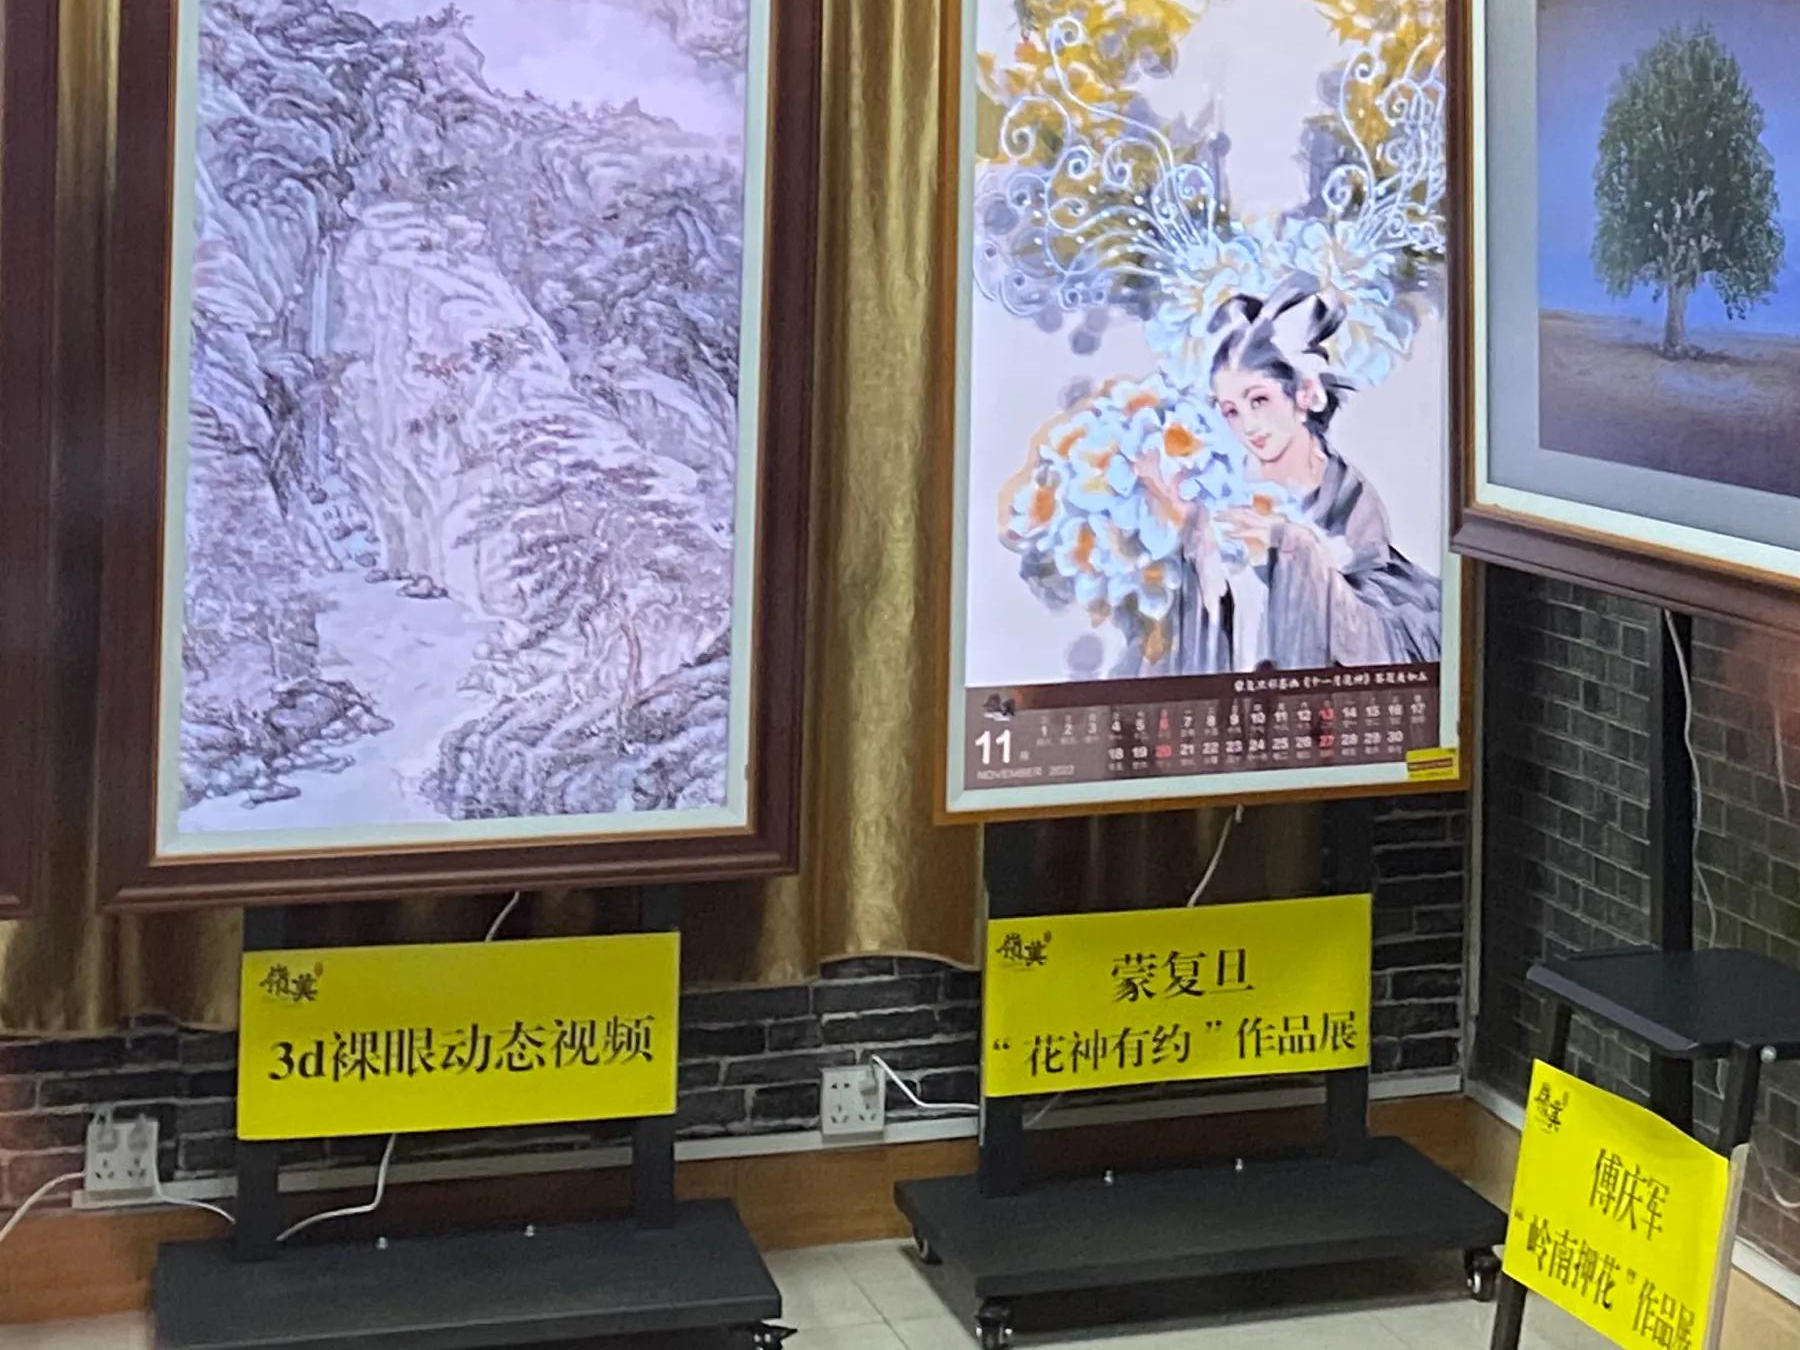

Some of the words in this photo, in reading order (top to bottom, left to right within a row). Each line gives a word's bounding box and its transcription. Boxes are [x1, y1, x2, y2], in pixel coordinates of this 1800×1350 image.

[1041, 725, 1048, 737] 1
[1064, 723, 1073, 735] 2
[1088, 722, 1097, 734] 3
[1111, 720, 1121, 732] 4
[1135, 718, 1145, 731] 5
[1184, 716, 1193, 727] 7
[1206, 715, 1216, 727] 8
[1230, 714, 1239, 726] 9
[1251, 712, 1266, 724] 10
[1274, 710, 1288, 722] 11
[1297, 709, 1312, 721] 12
[1342, 706, 1358, 718] 14
[1365, 705, 1380, 717] 15
[1388, 704, 1403, 716] 16
[1410, 702, 1426, 715] 17
[974, 728, 1011, 765] 11
[1108, 747, 1124, 760] 18
[1132, 746, 1148, 758] 19
[1180, 743, 1195, 756] 21
[1202, 741, 1219, 755] 22
[1249, 738, 1265, 752] 24
[1272, 737, 1289, 749] 25
[1319, 734, 1335, 747] 27
[1341, 733, 1358, 746] 28
[1364, 732, 1381, 745] 29
[1387, 730, 1404, 743] 30
[1111, 947, 1255, 1003] 蒙复旦
[268, 1014, 656, 1083] 3d裸眼动态视频
[1589, 1148, 1670, 1241] 傅庆军
